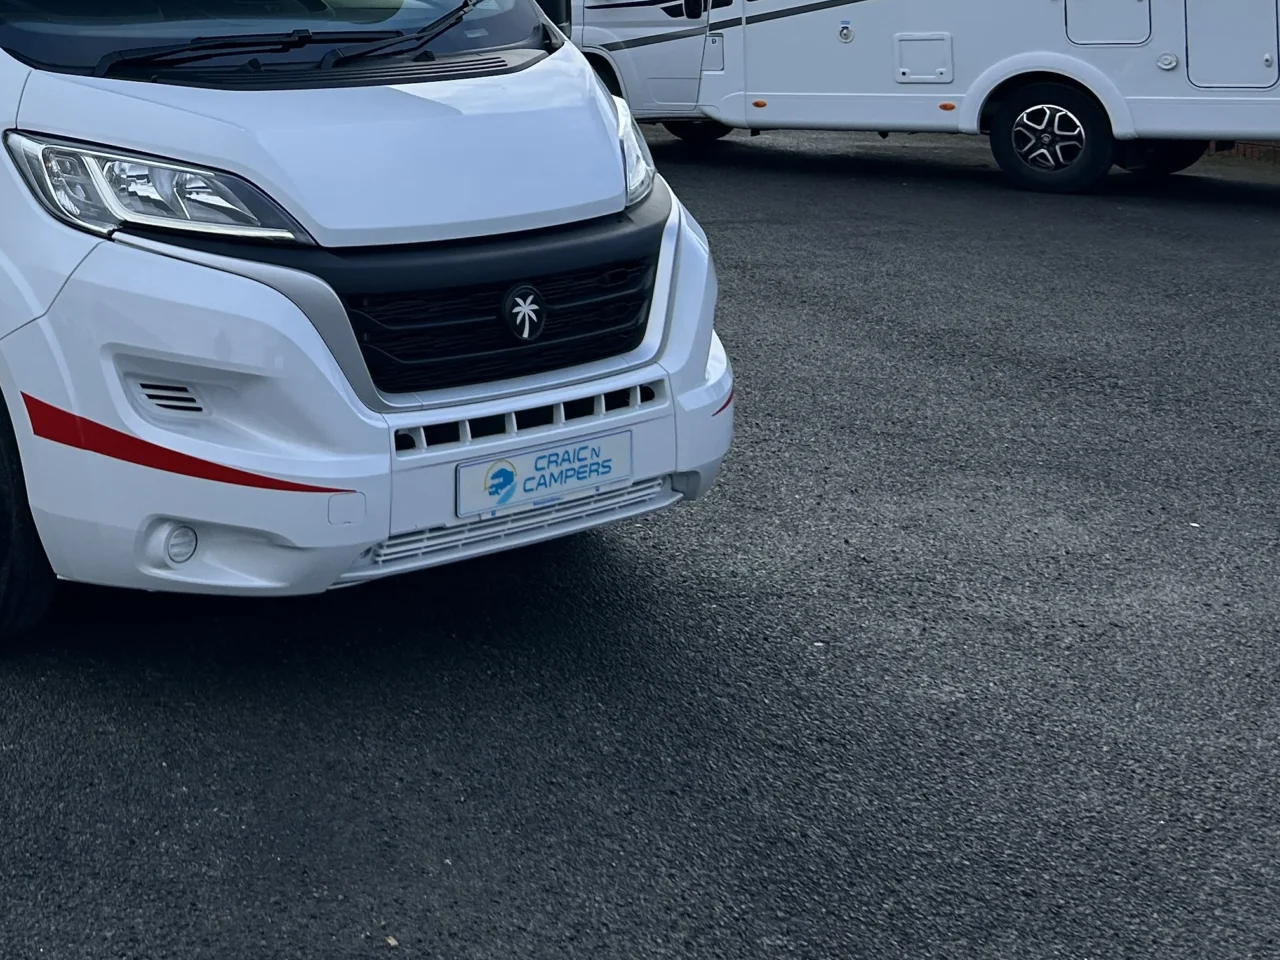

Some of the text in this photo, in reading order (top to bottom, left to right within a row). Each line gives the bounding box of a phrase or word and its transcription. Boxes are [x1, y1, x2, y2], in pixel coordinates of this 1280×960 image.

[534, 445, 601, 472] CRAIC N
[523, 458, 612, 493] CAMPERS
